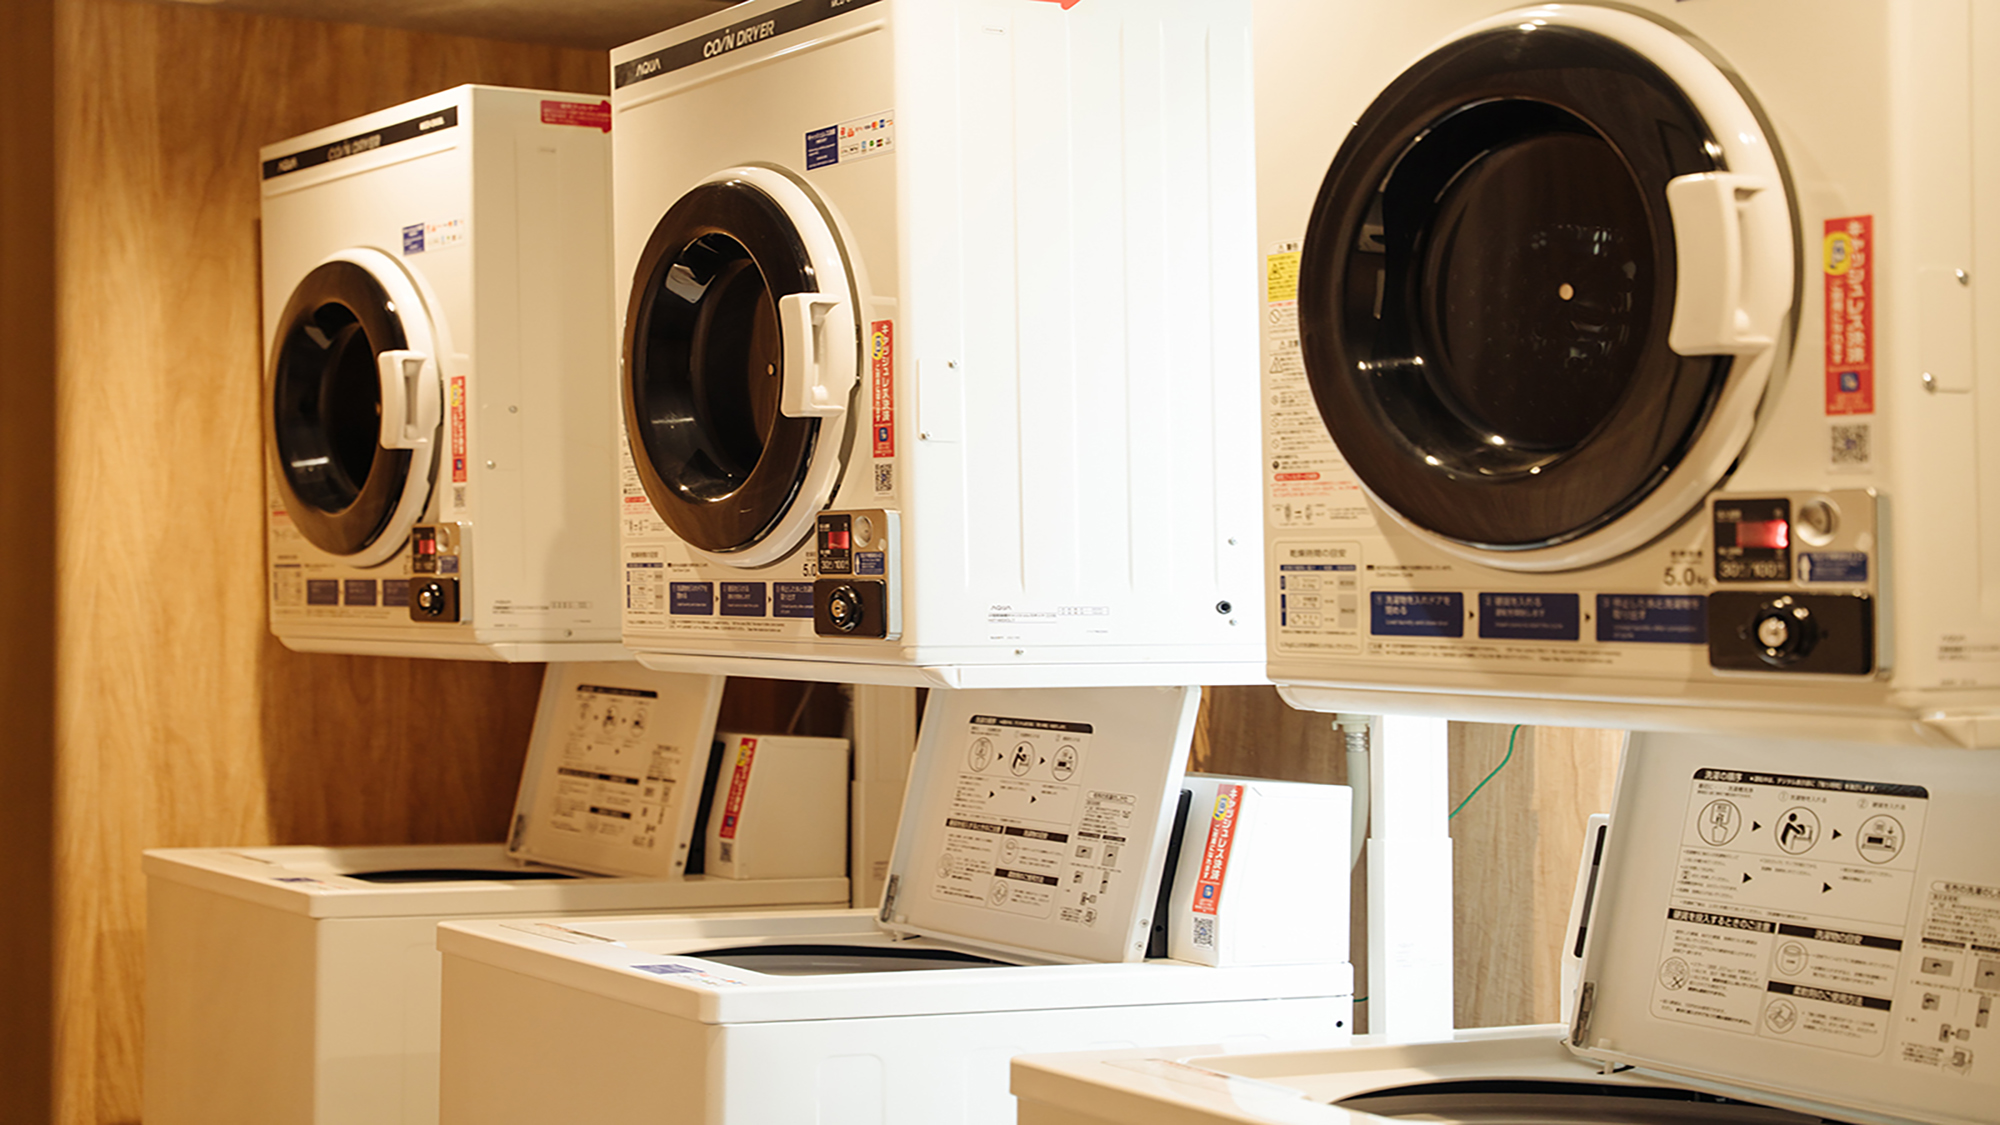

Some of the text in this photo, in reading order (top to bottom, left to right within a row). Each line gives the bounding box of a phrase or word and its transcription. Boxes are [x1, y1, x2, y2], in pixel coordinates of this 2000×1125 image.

[736, 20, 775, 47] DRYER
[635, 58, 661, 77] AQUA
[1210, 788, 1238, 880] キャッシュレス決済
